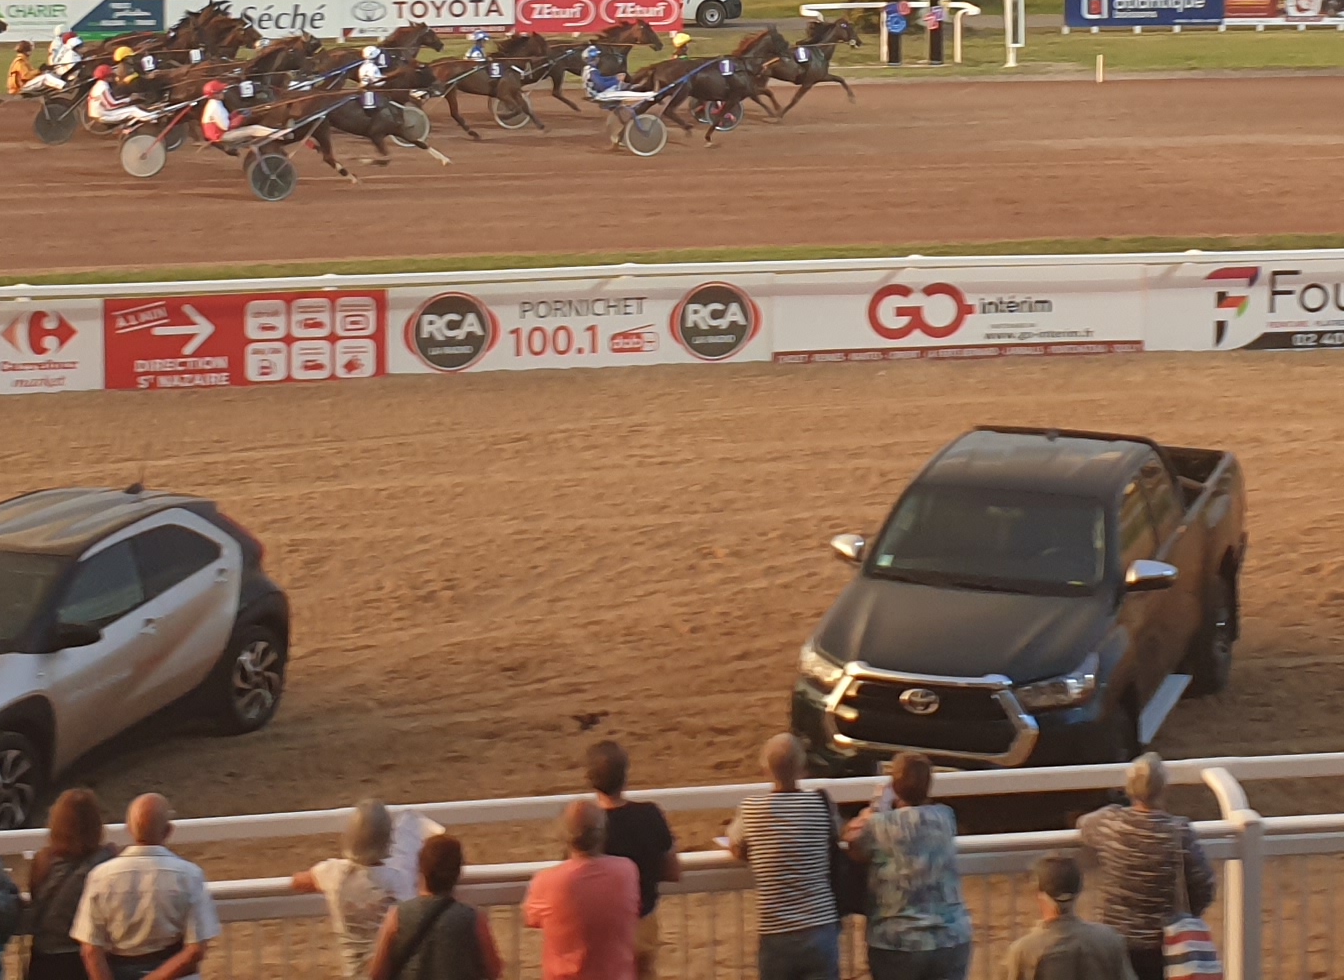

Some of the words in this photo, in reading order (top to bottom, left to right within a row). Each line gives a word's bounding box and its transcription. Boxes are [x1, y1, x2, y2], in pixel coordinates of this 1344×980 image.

[8, 4, 68, 18] CHARIER
[241, 3, 327, 30] Séché
[392, 0, 505, 19] TOYOTA
[530, 2, 584, 19] ZEturf
[613, 1, 669, 18] ZEturf
[519, 296, 648, 320] PORNICHET
[685, 302, 748, 330] RCA
[867, 281, 970, 340] GO
[420, 312, 486, 340] RCA
[508, 324, 600, 357] 100.1
[1291, 332, 1318, 347] 02
[133, 355, 229, 373] DIRECTION
[156, 372, 231, 388] NAZAIRE
